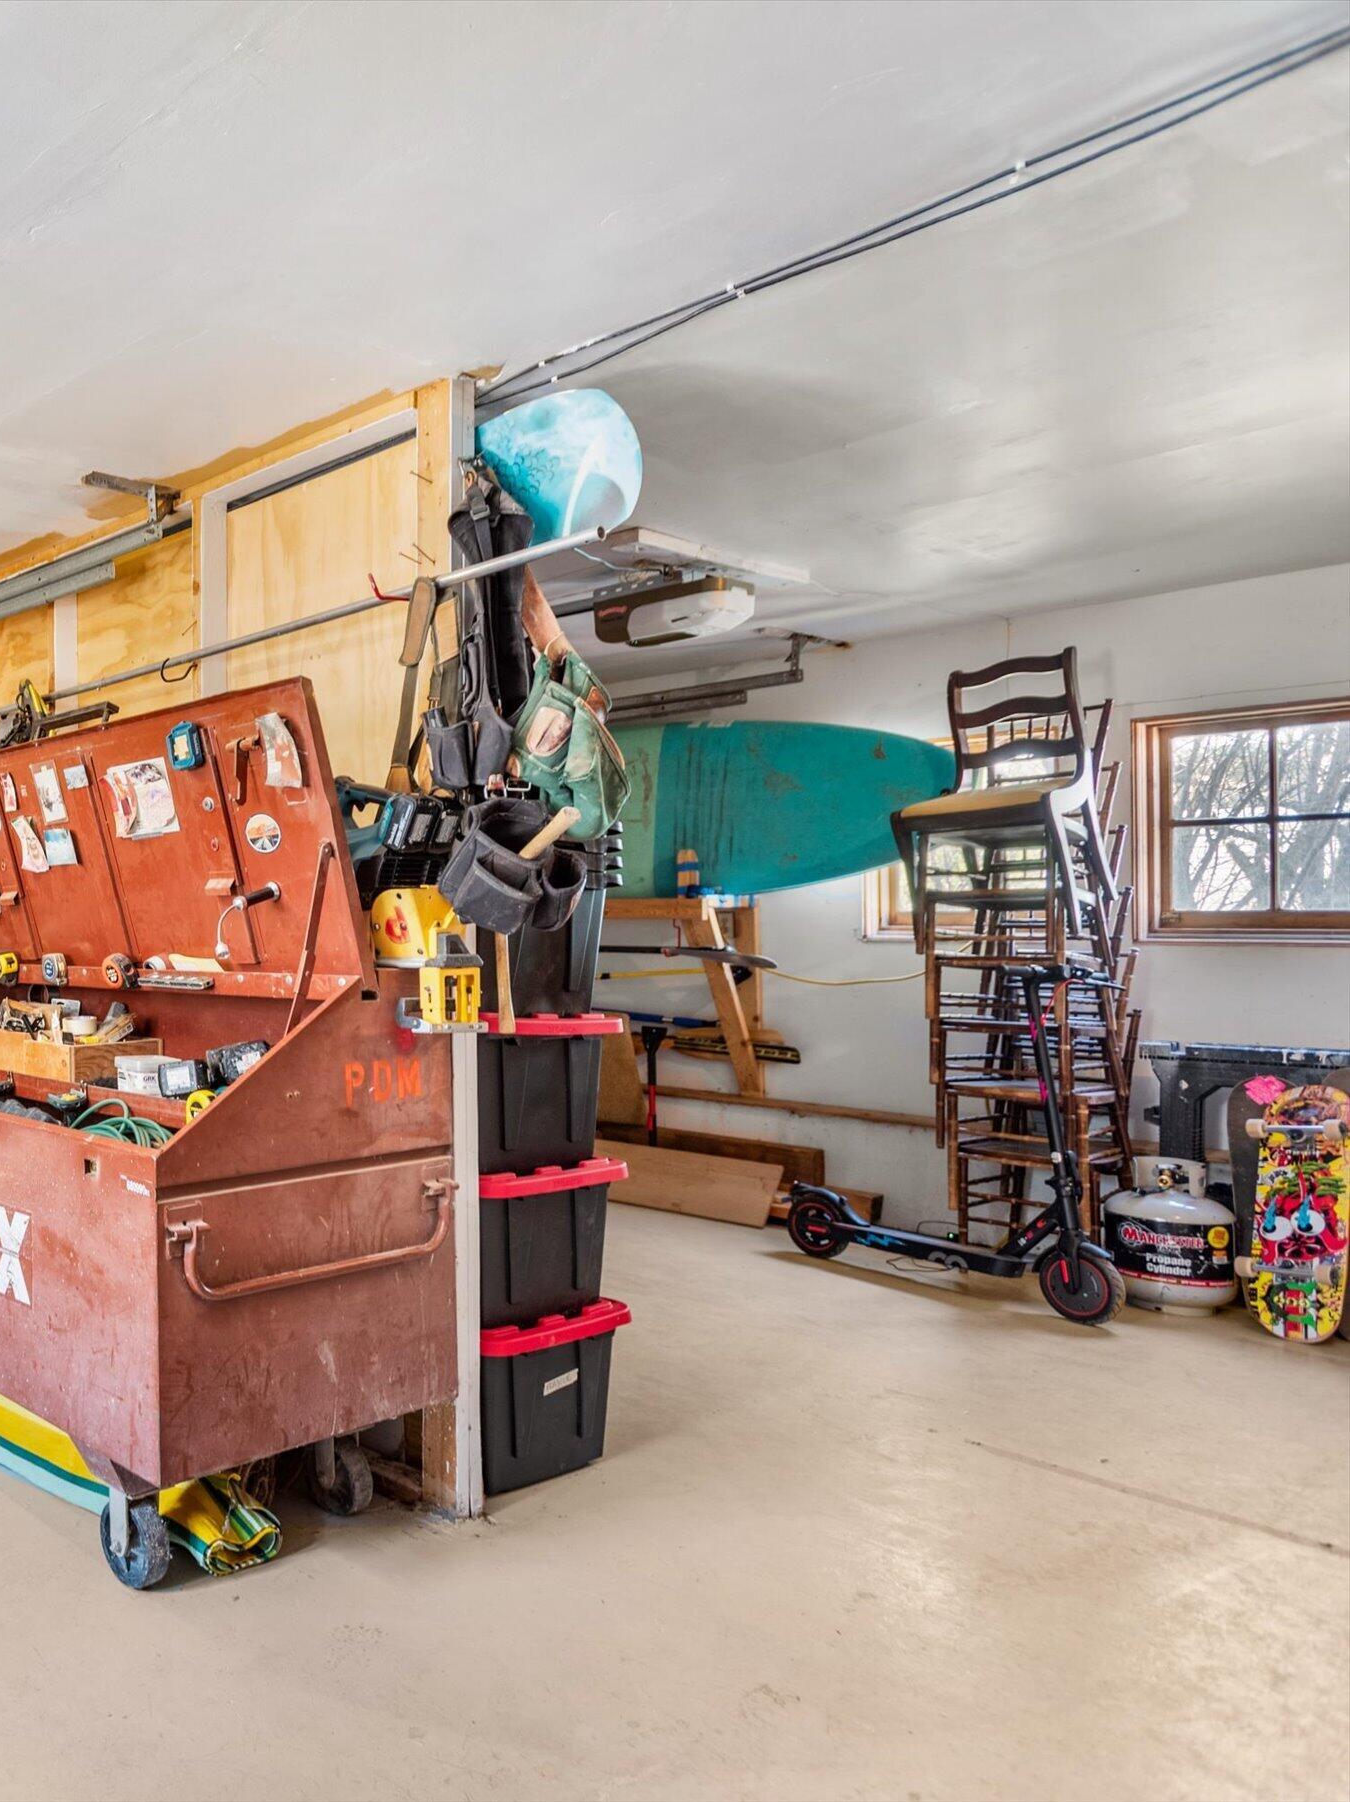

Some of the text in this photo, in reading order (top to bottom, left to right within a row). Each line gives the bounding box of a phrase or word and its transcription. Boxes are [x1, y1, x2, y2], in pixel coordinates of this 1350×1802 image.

[344, 1056, 423, 1108] PDM
[1145, 1252, 1192, 1267] Propane
[1145, 1263, 1192, 1277] Cylinder
